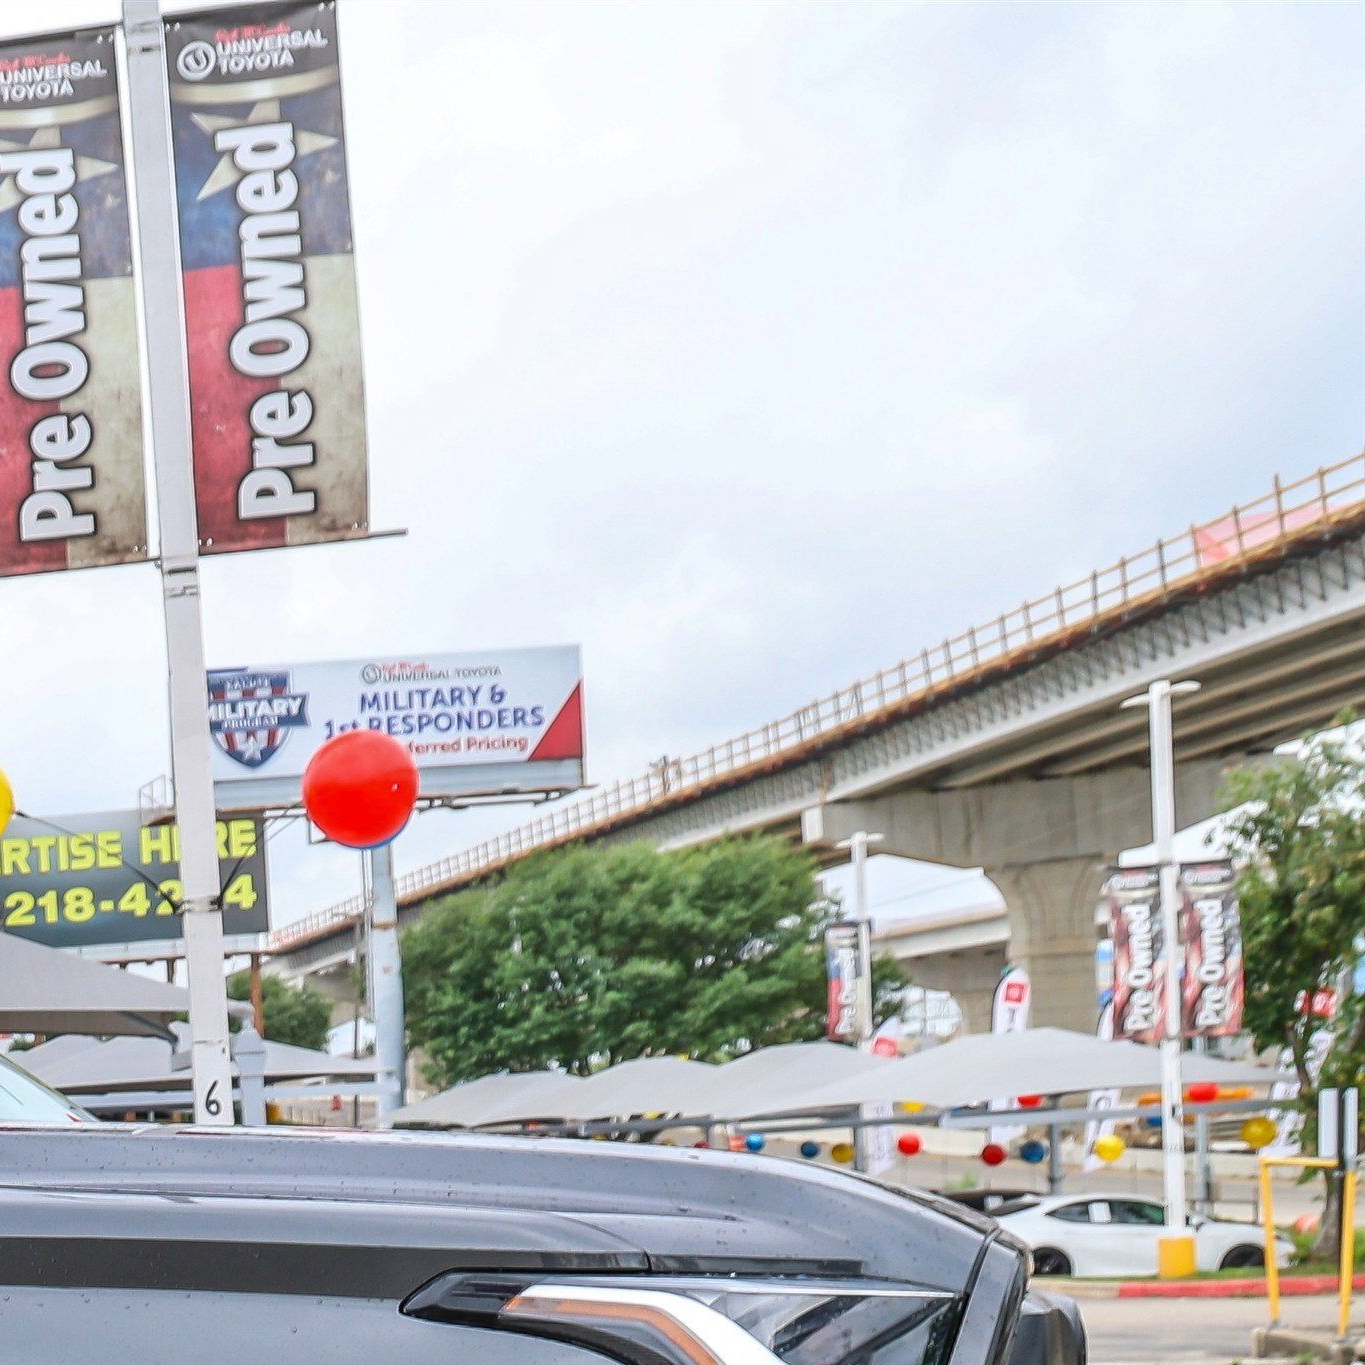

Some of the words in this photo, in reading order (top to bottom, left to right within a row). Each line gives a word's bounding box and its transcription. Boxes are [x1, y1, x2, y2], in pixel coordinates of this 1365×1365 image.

[216, 29, 328, 55] UNIVERSAL
[219, 49, 294, 75] TOYOTA
[0, 79, 75, 103] TOYOTA
[214, 121, 311, 377] Owned
[237, 390, 317, 521] Pre
[19, 412, 96, 543] Pre
[456, 666, 501, 678] TOYOTA
[361, 685, 482, 713] MILITARY
[491, 684, 506, 704] &
[369, 706, 545, 736] RESPONDERS
[467, 737, 528, 753] Pricing
[4, 873, 258, 927] 218-424
[1123, 989, 1154, 1031] Pre
[1195, 984, 1227, 1026] Pre
[205, 1079, 221, 1116] 6
